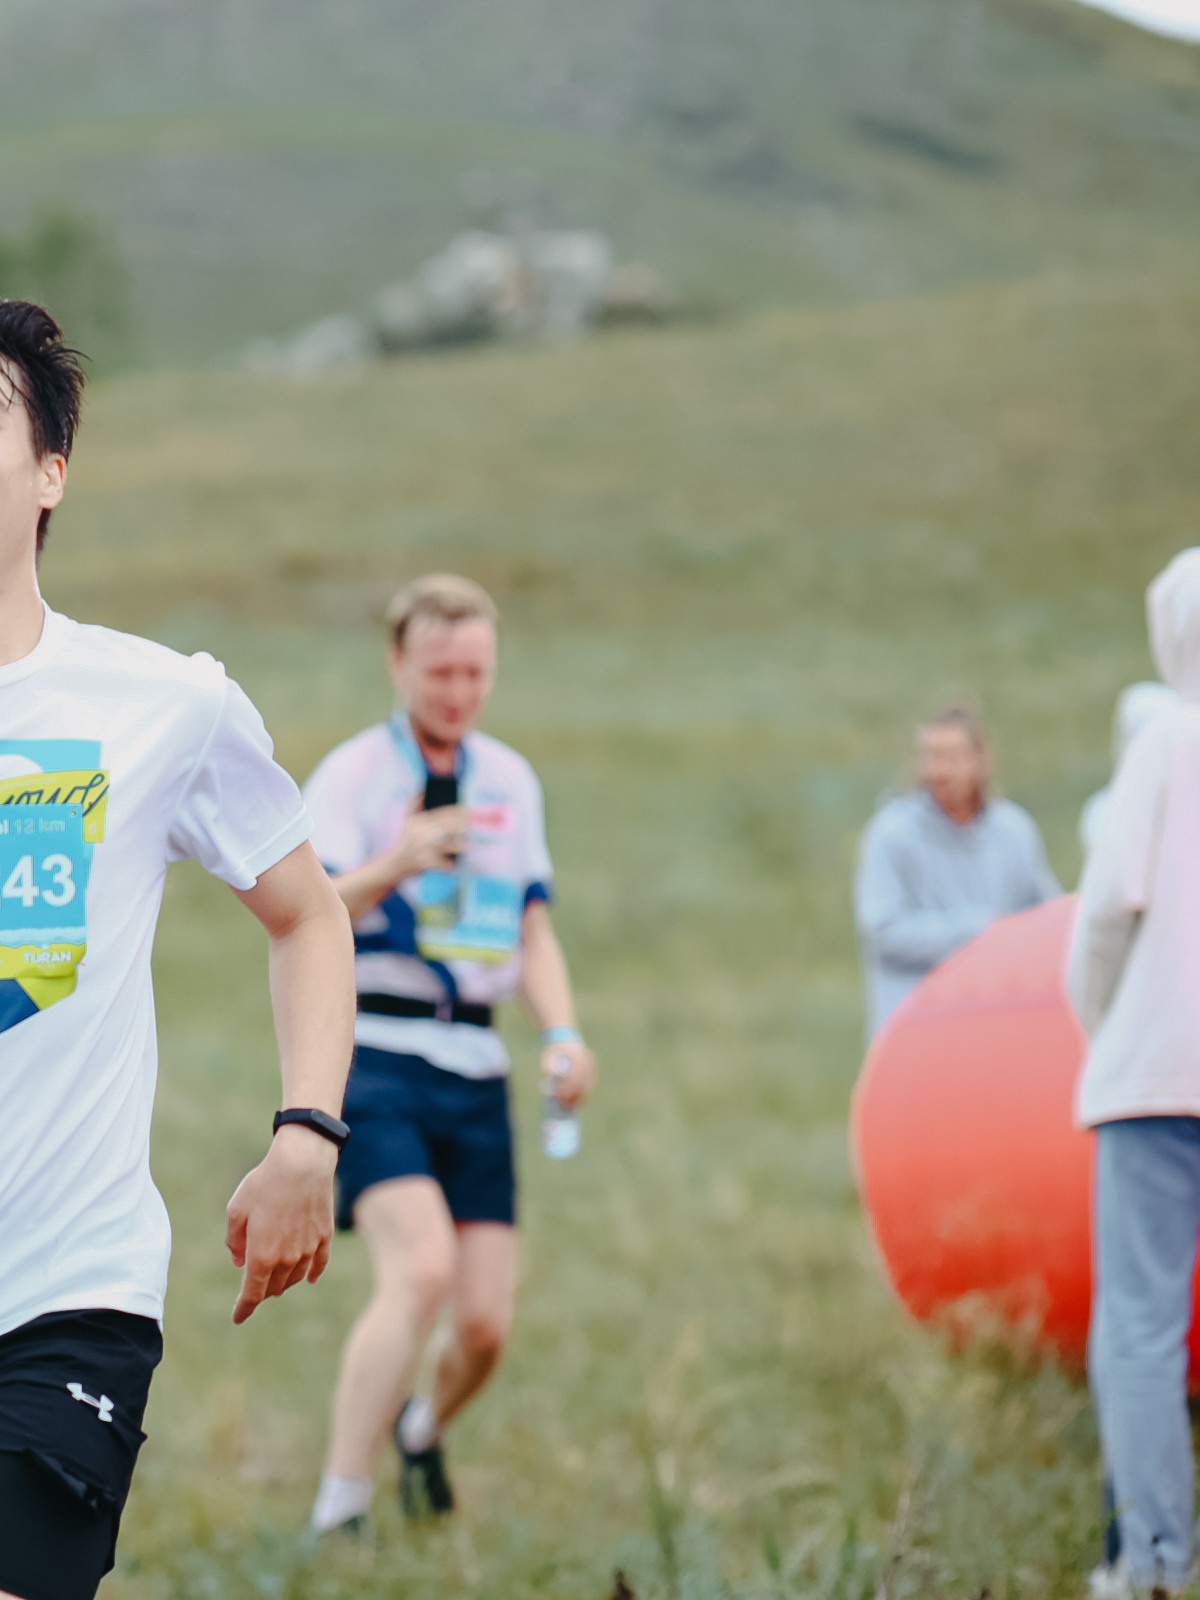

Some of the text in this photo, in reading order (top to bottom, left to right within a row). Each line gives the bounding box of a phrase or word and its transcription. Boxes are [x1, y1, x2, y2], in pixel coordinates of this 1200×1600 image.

[15, 818, 35, 834] 12
[39, 818, 66, 832] km
[23, 951, 73, 964] TURAN
